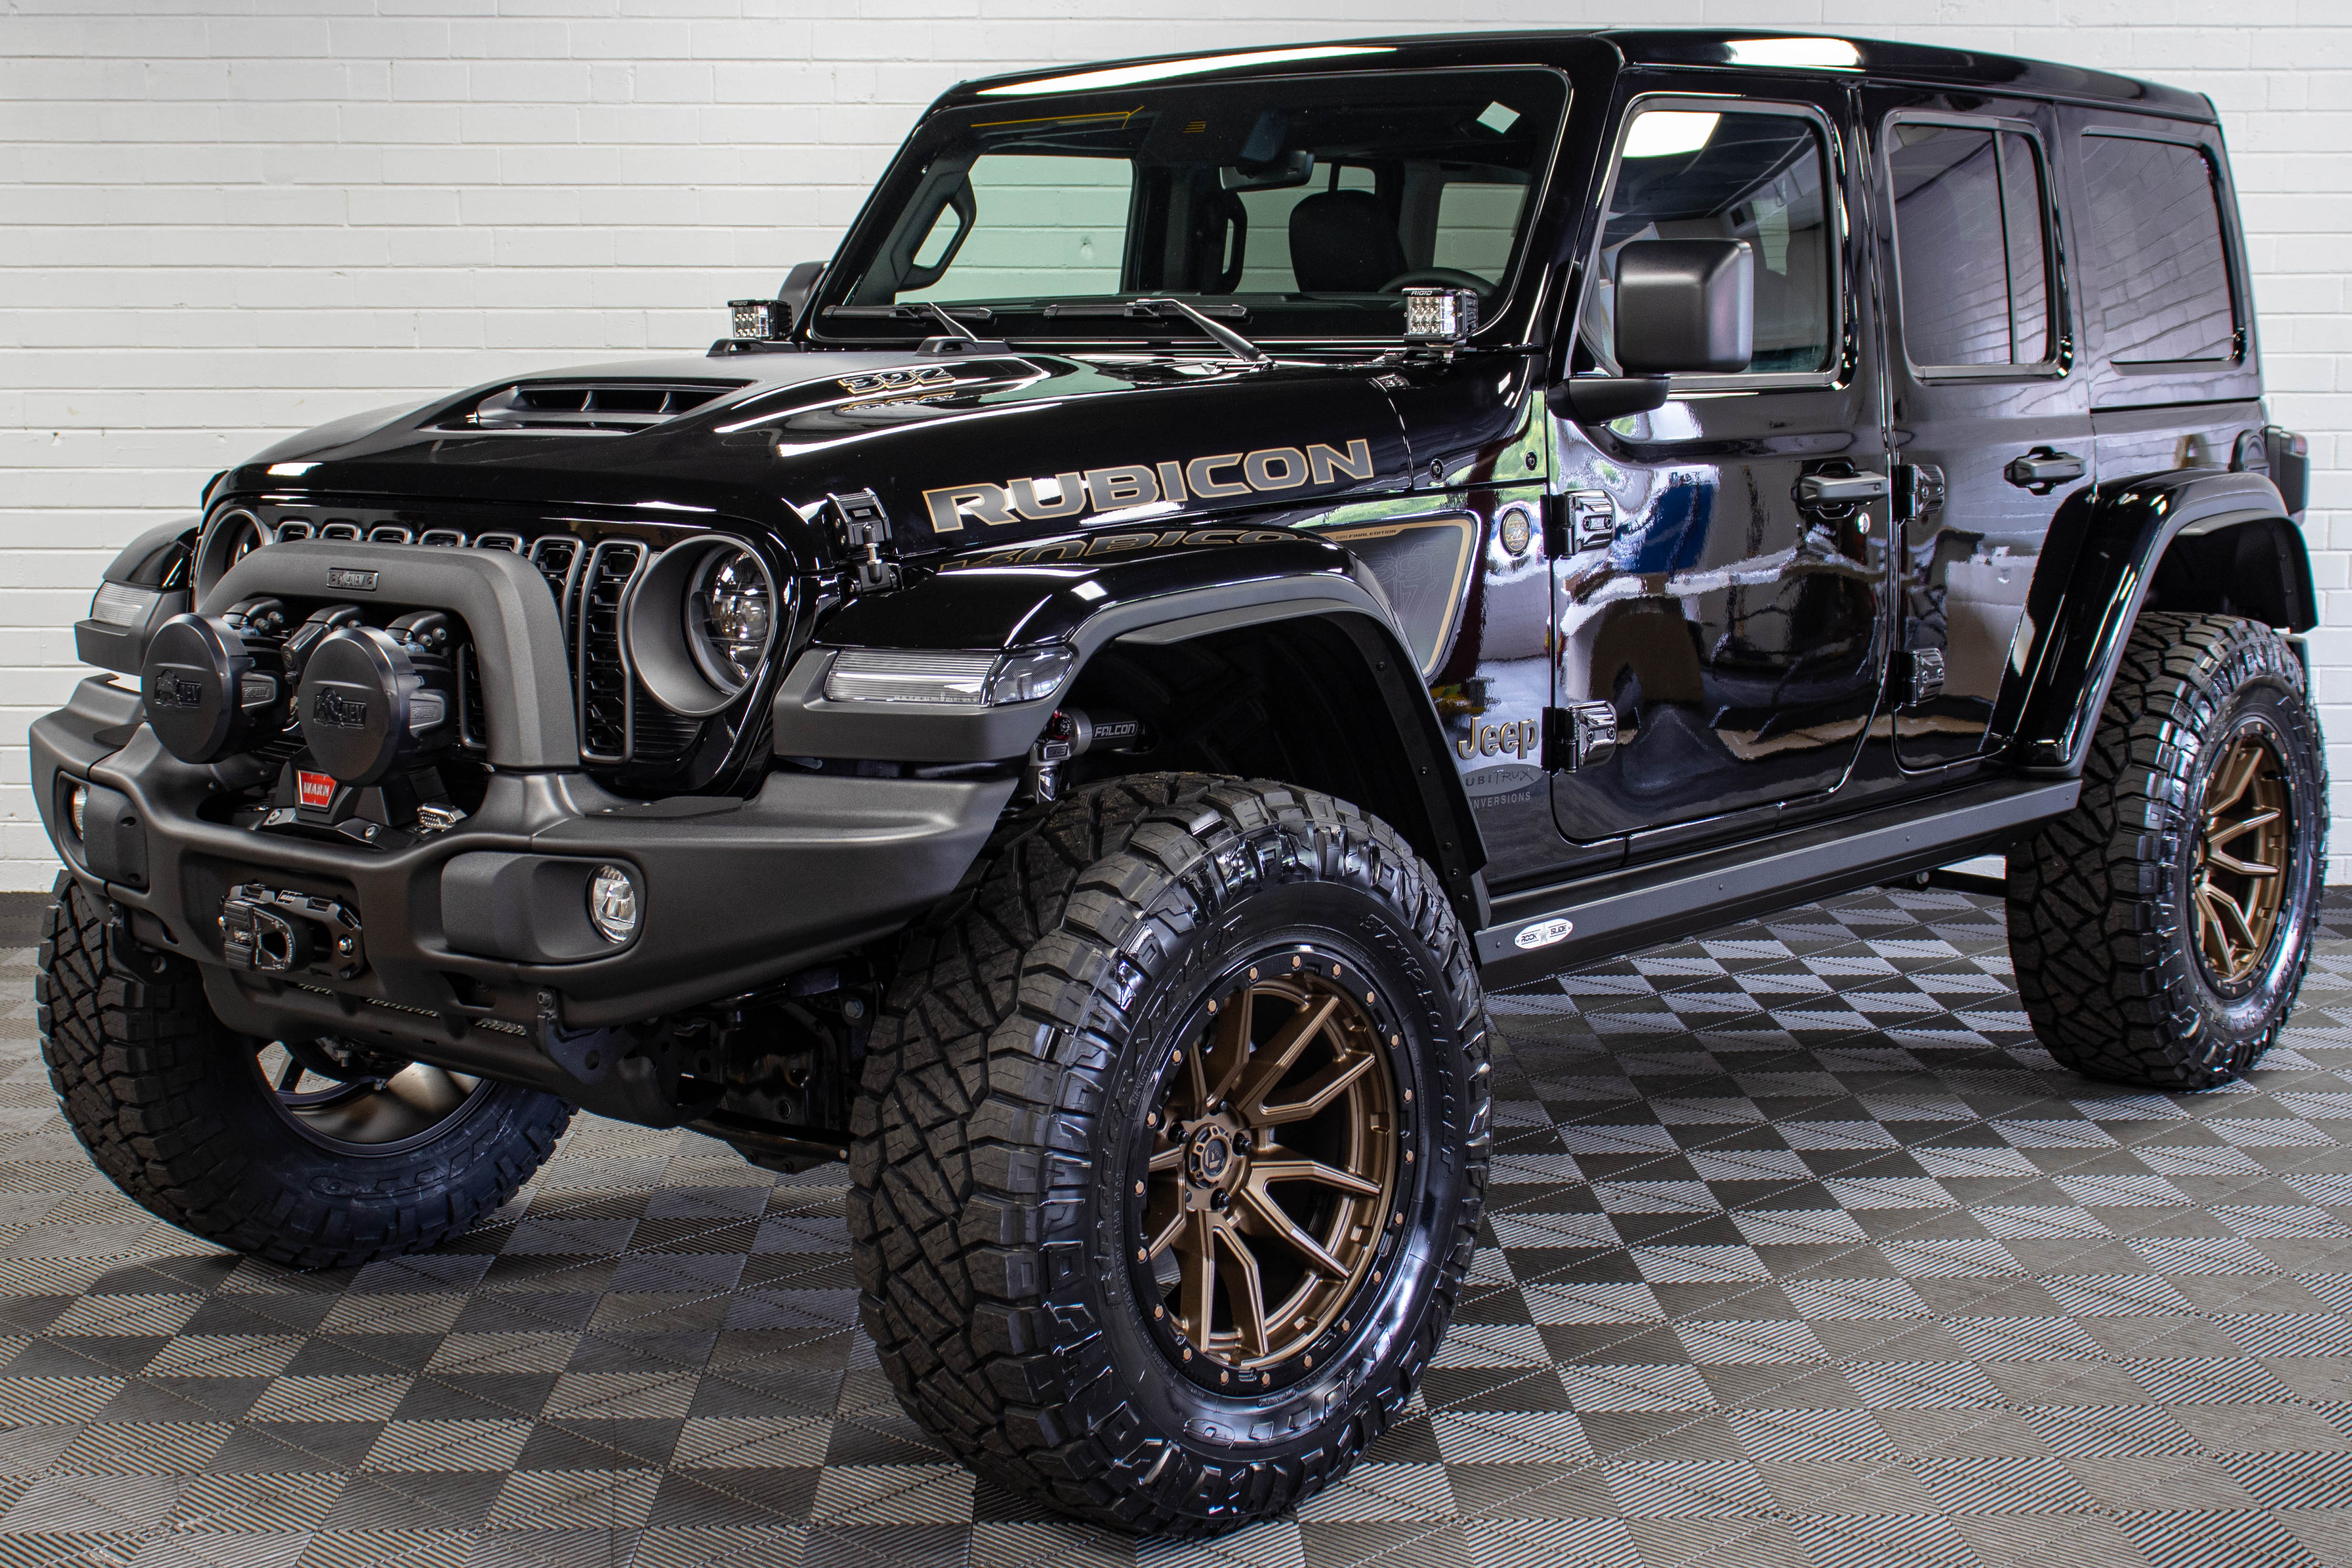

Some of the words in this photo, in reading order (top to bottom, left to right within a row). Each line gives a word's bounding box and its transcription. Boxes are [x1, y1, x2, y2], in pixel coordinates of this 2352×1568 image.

[838, 367, 955, 396] 392
[923, 439, 1374, 533] RUBICON
[1095, 723, 1135, 738] FALCON
[1458, 716, 1540, 760] Jeep
[1465, 769, 1534, 787] UBITRUX
[303, 782, 330, 797] WARN
[1474, 791, 1531, 809] NVERSIONS
[1521, 933, 1538, 943] ROCK
[1551, 925, 1567, 935] SLIDE
